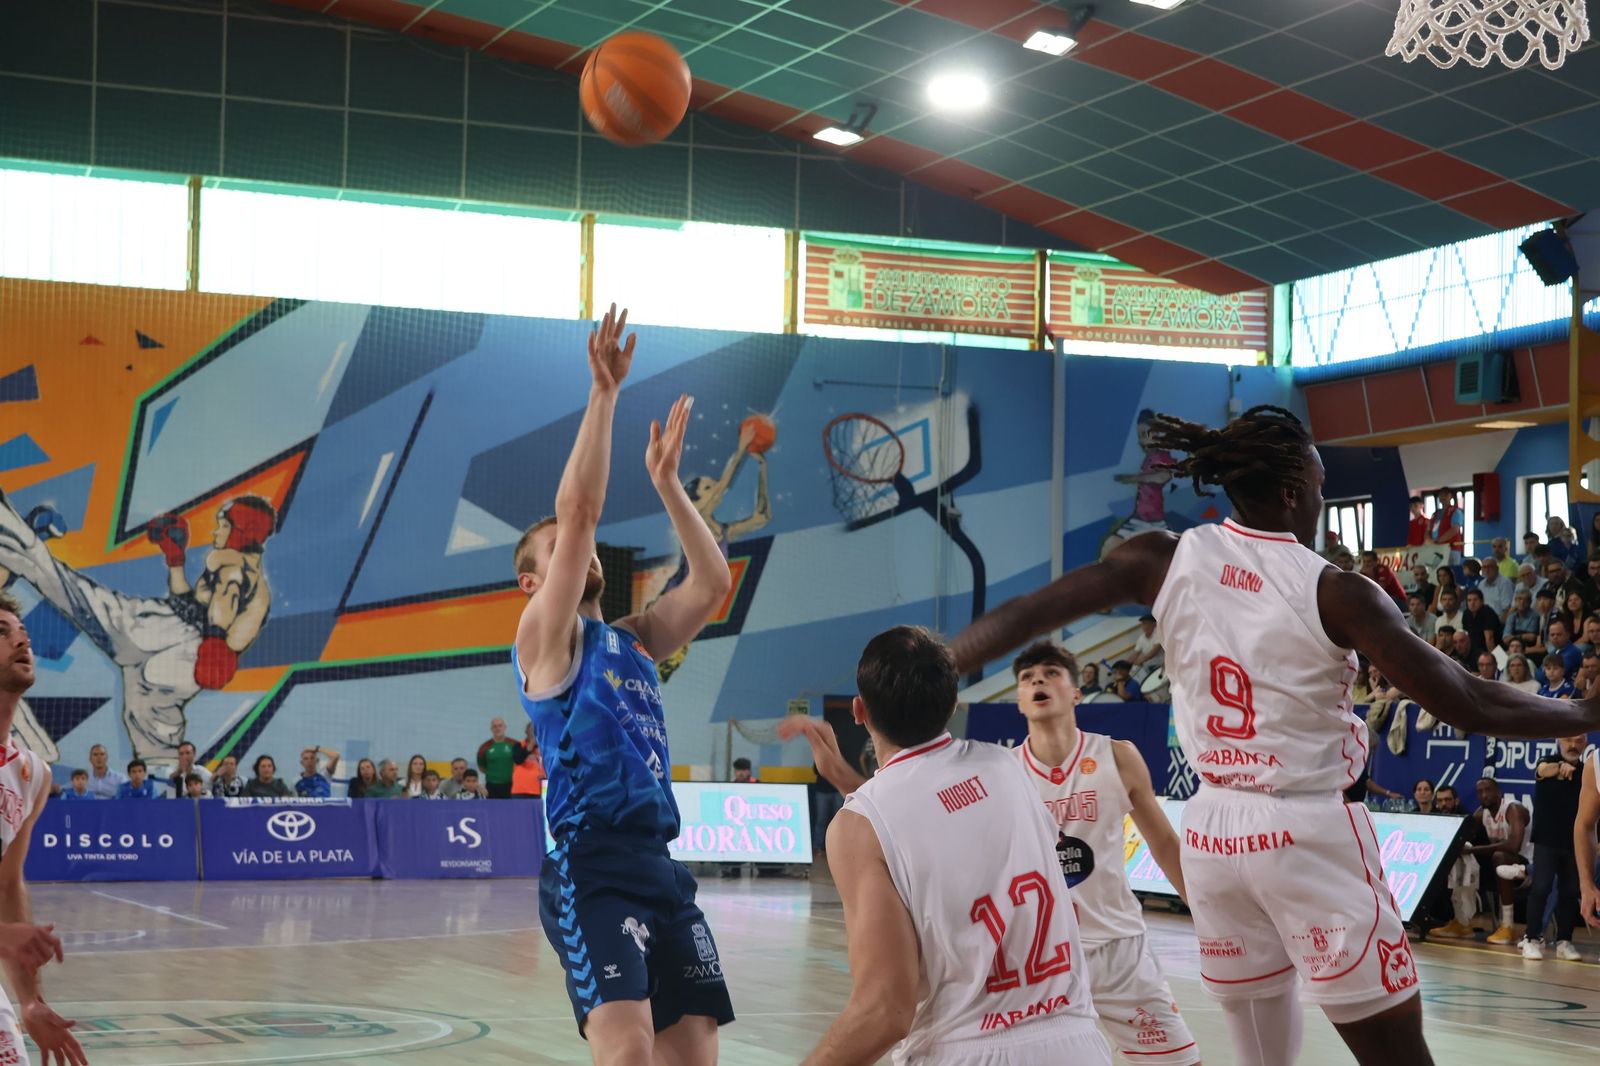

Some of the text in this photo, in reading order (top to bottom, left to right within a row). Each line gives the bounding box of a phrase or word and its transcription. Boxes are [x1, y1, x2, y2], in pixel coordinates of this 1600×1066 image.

[874, 268, 1011, 296] AYUNTAMIENTO
[872, 287, 1011, 319] DE ZAMORA
[1112, 302, 1243, 330] DE ZAMORA
[921, 322, 935, 331] DE
[943, 324, 1006, 335] DEPORTES
[1159, 335, 1173, 344] DE
[1180, 336, 1239, 347] DEPORTES
[1206, 654, 1256, 740] 9
[936, 775, 989, 814] HUGUET
[723, 795, 793, 825] QUESO
[43, 833, 174, 848] DISCOLO
[676, 823, 796, 853] MORANO
[67, 853, 138, 861] UVA TINTA DE TORO
[232, 848, 354, 865] VÍA DE LA PLATA
[1056, 847, 1083, 860] rella
[1061, 861, 1082, 873] icia
[969, 870, 1071, 994] 12
[682, 960, 722, 978] ZAMO
[981, 995, 1070, 1031] ABANA
